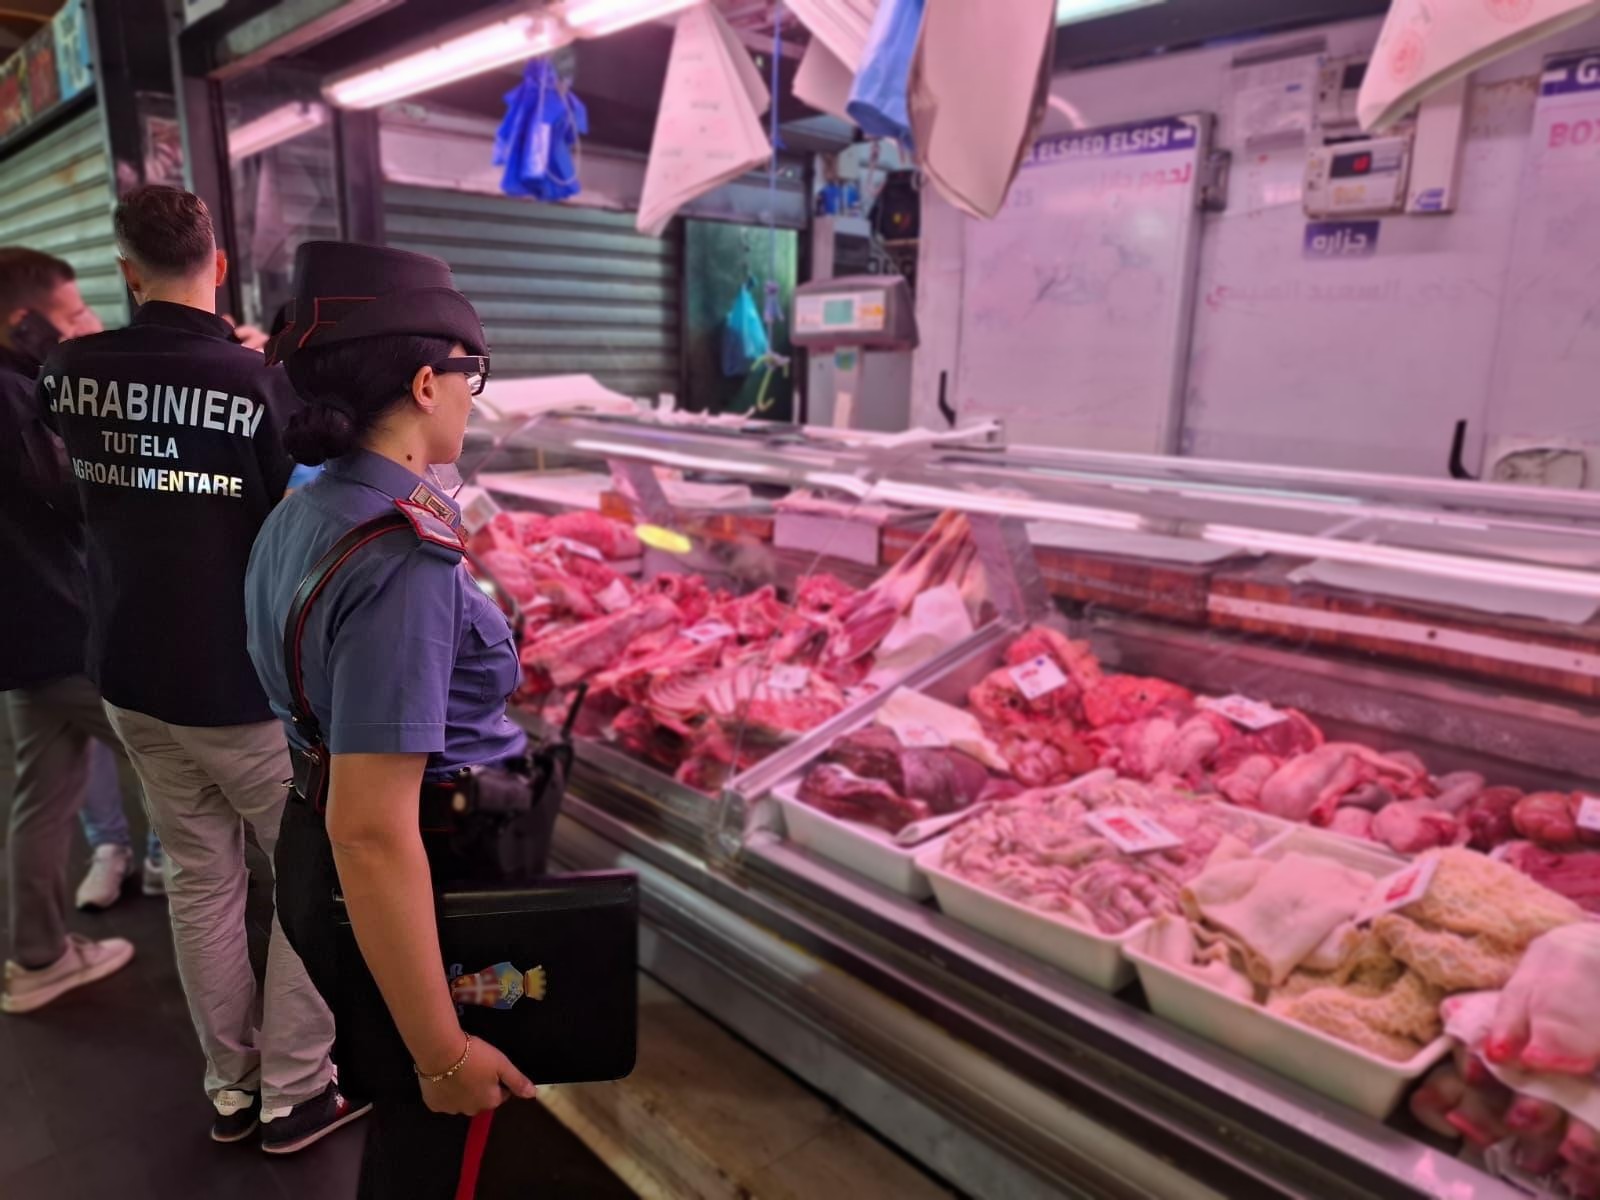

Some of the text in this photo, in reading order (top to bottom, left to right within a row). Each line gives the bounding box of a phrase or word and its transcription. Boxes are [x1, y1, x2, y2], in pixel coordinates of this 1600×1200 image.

[1109, 126, 1170, 152] ELSISI
[43, 375, 265, 439] CARABINIERI
[102, 430, 179, 459] TUTELA
